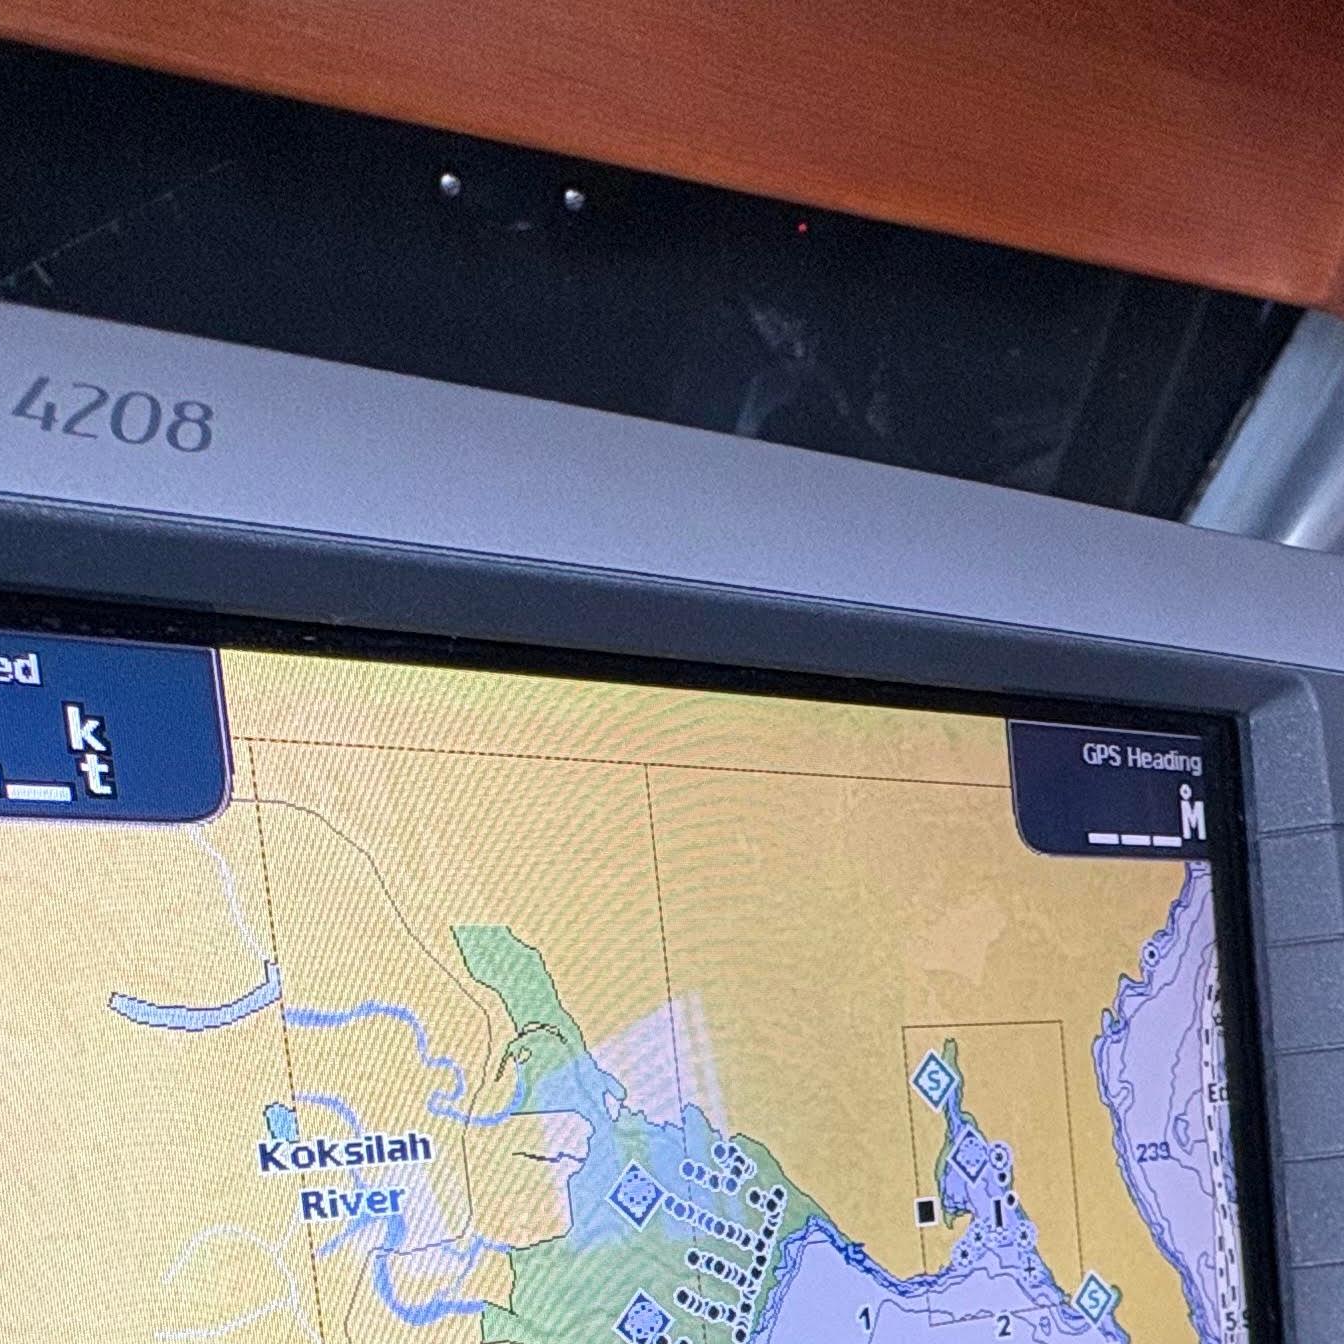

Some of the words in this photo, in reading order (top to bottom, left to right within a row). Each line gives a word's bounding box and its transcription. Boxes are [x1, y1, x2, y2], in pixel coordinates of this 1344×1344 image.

[11, 374, 214, 453] 4208
[1082, 742, 1122, 767] GPS
[1127, 746, 1203, 777] Heading
[257, 1134, 433, 1172] Koksilah
[1136, 1141, 1171, 1163] 239
[300, 1187, 406, 1220] River
